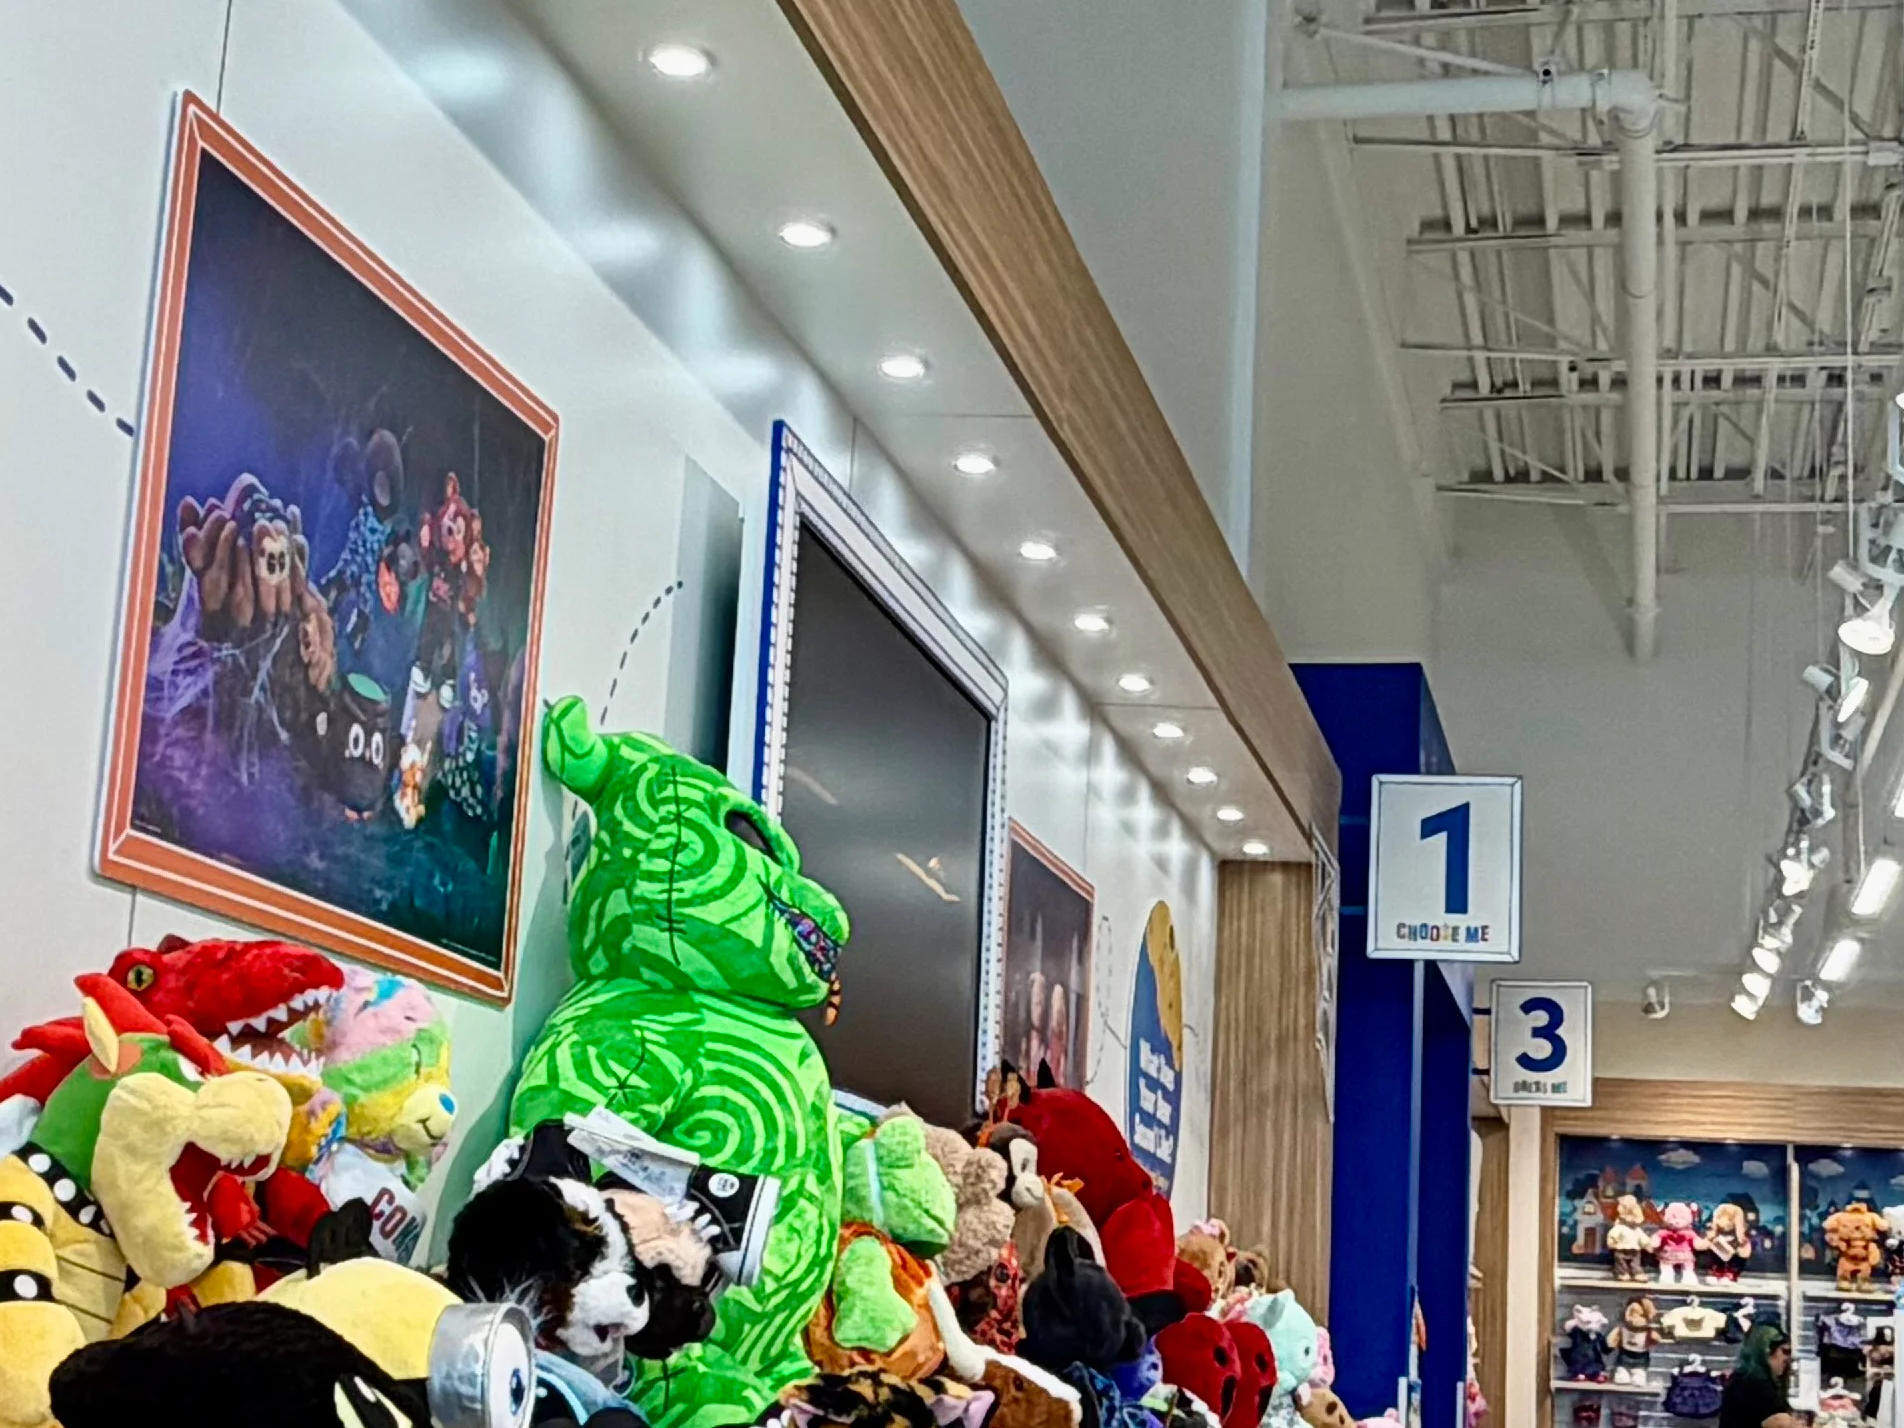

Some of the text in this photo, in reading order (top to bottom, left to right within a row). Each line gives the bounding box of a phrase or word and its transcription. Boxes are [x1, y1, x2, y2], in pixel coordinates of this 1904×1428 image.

[1420, 801, 1470, 915] 1
[1396, 922, 1490, 943] CHOOSE ME
[1515, 996, 1568, 1073] 3
